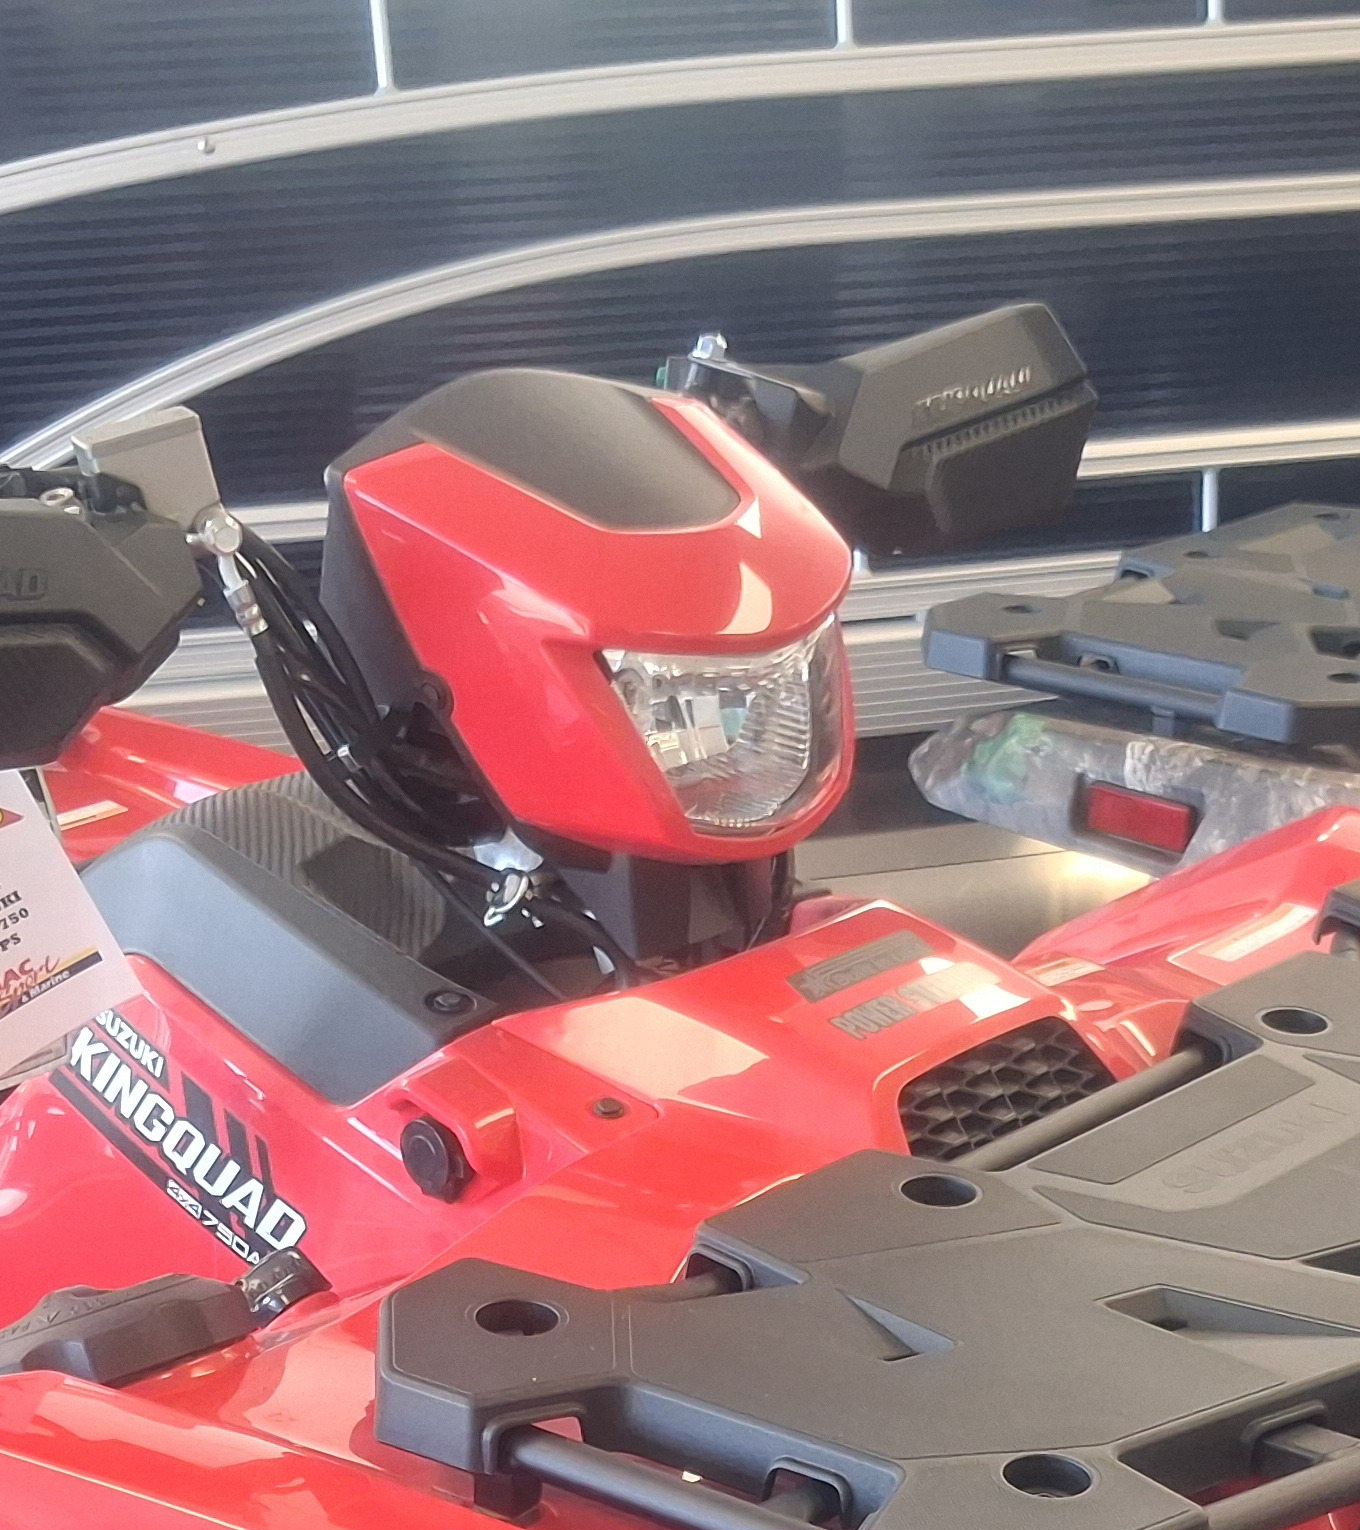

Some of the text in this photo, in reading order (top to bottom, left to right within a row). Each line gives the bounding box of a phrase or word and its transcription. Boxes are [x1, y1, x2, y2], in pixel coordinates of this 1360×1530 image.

[29, 969, 71, 999] Marine
[95, 1008, 165, 1079] SUZUKI
[827, 993, 920, 1041] POWER
[69, 1026, 308, 1251] KINGQUAD
